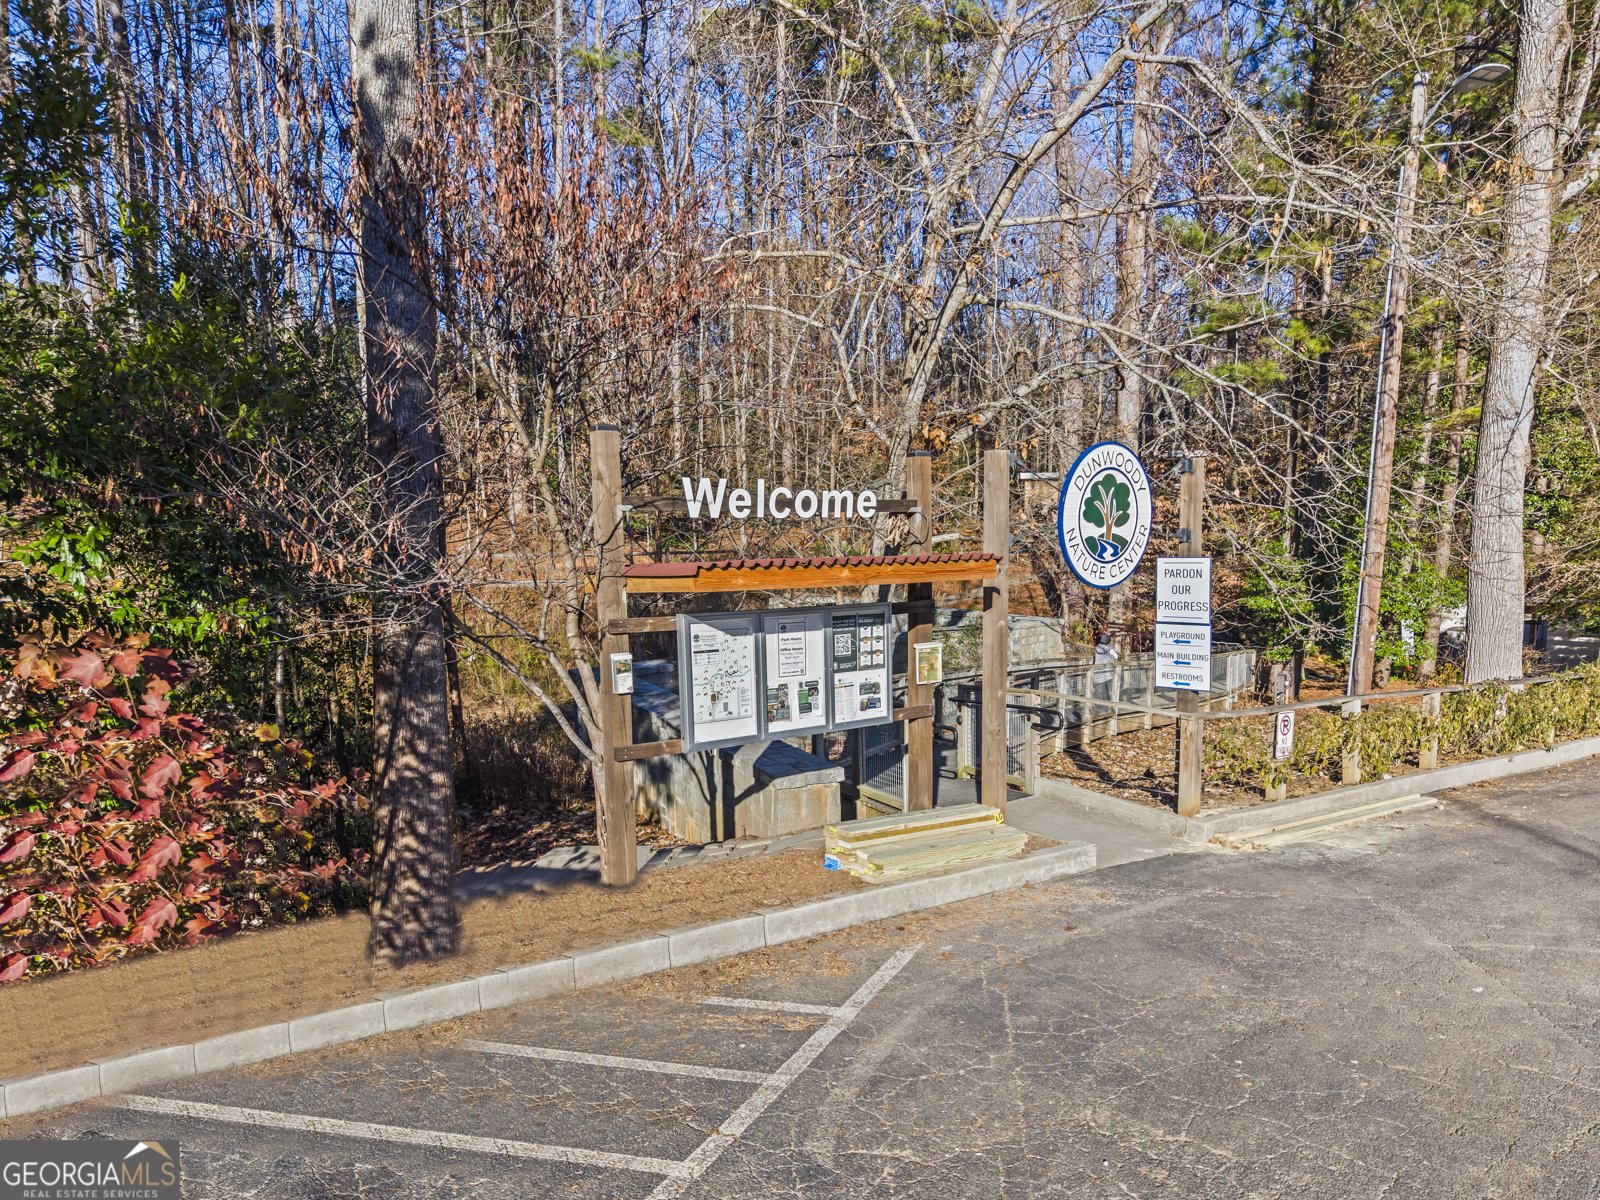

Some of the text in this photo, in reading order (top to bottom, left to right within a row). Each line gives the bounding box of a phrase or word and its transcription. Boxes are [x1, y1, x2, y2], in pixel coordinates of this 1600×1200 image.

[1073, 450, 1147, 494] DUNWOODY
[681, 476, 877, 519] Welcome
[1066, 523, 1148, 580] NATURE CENTER
[1164, 568, 1203, 579] PARDON
[1171, 584, 1191, 595] OUR
[1158, 600, 1209, 612] PROGRESS
[1160, 630, 1206, 641] PLAYGROUND
[1157, 651, 1209, 662] MAIN BUILDING
[1161, 671, 1204, 682] RESTROOMS
